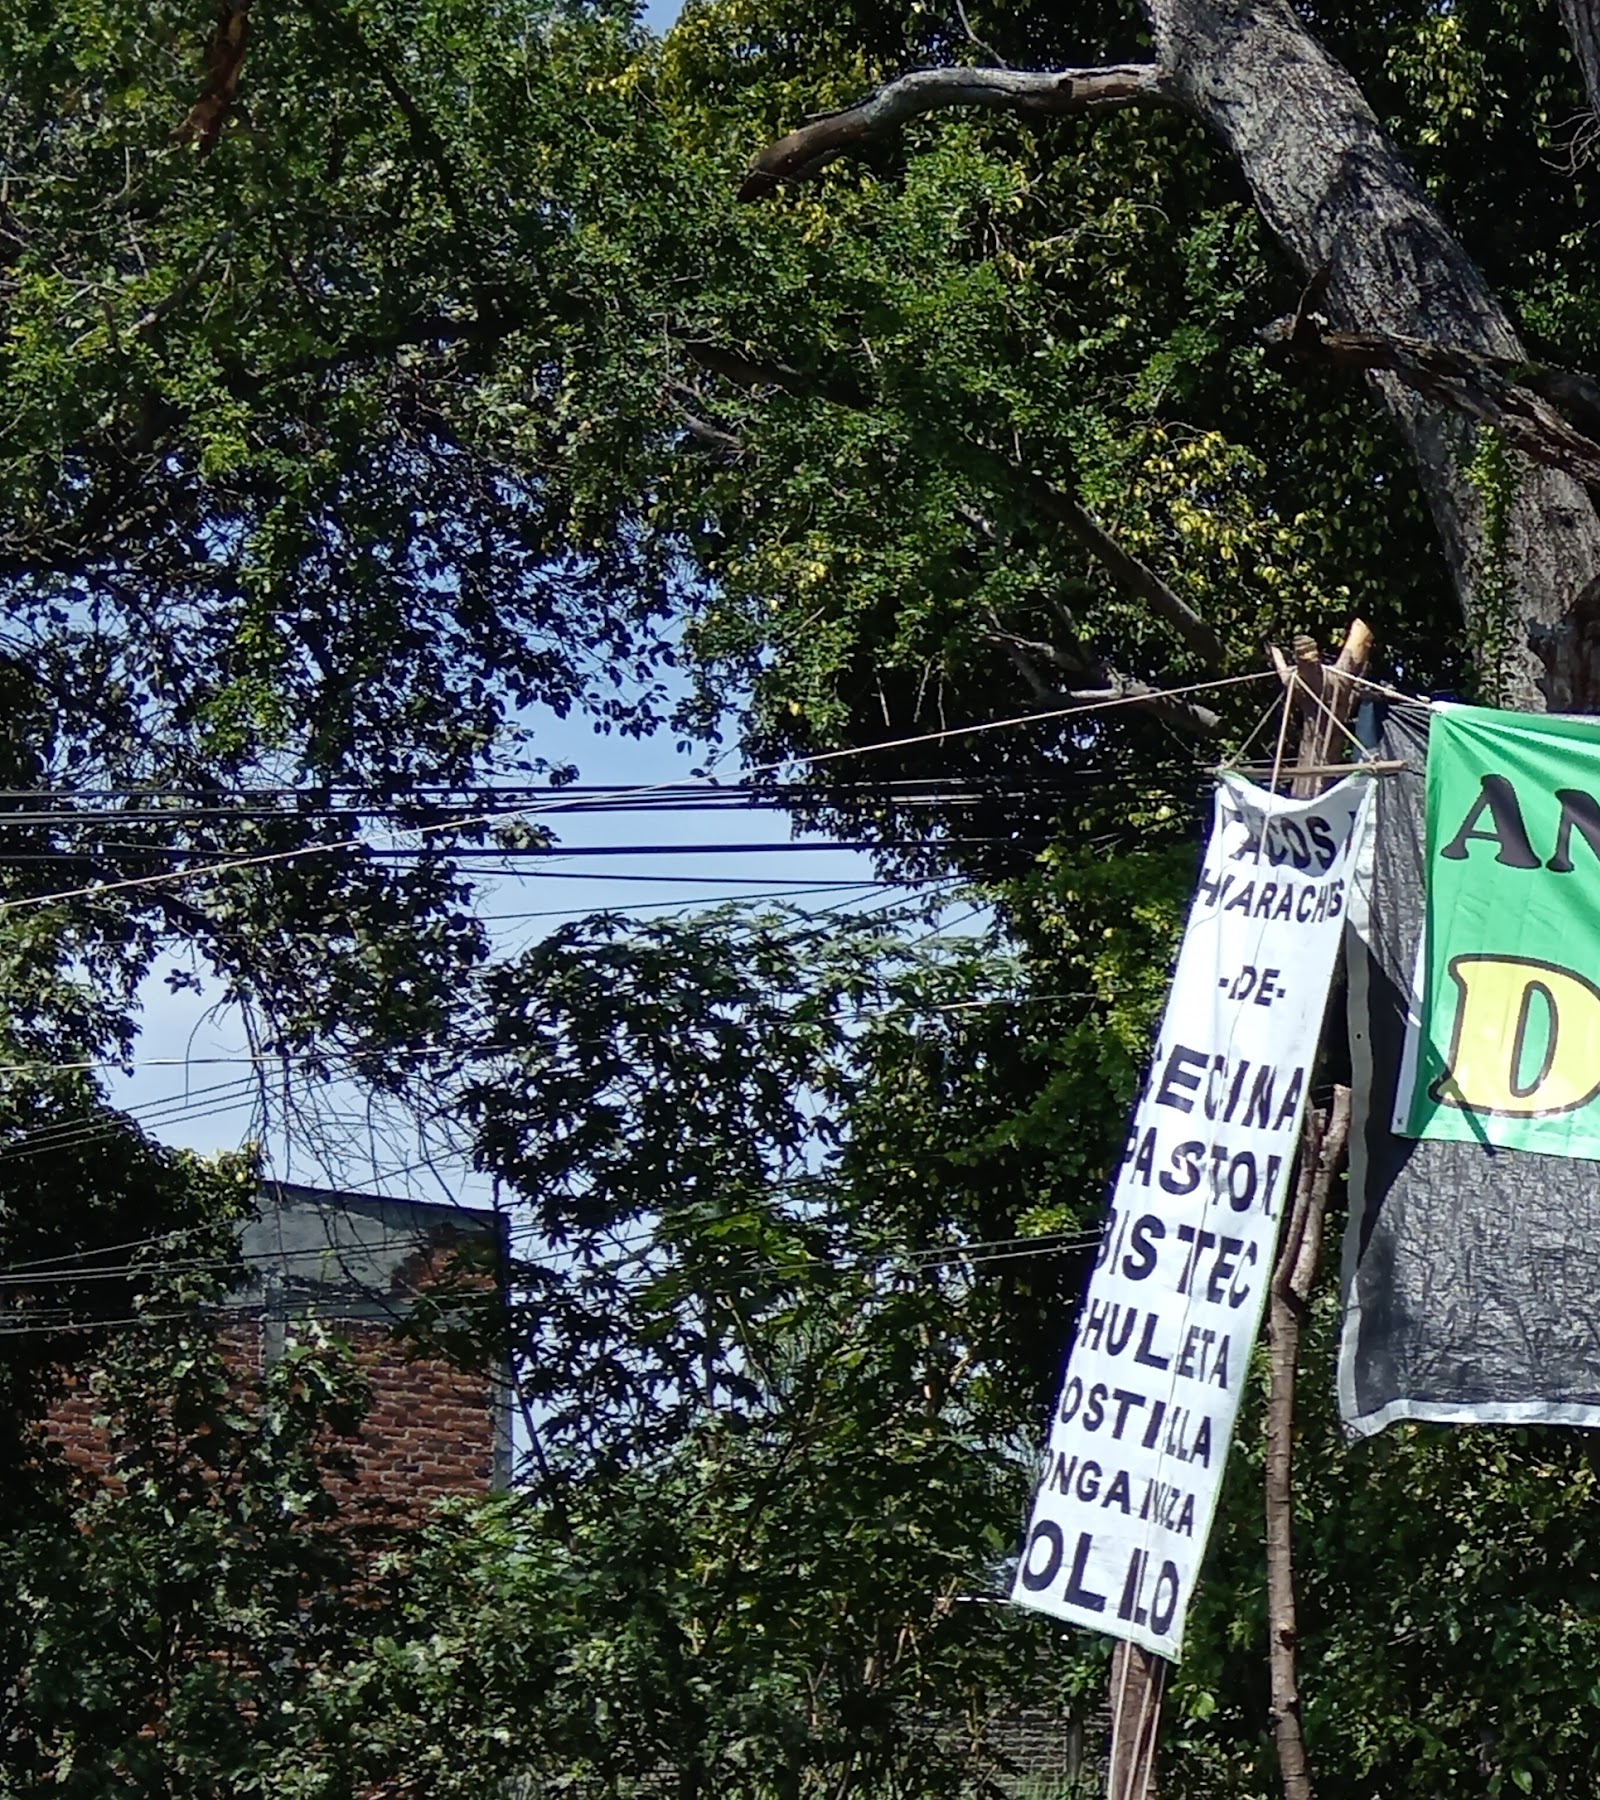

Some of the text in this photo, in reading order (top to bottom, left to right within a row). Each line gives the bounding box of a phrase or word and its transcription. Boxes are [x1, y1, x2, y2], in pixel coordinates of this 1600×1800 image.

[1218, 965, 1287, 1006] -DE-
[1143, 1042, 1305, 1132] ECINA
[1079, 1297, 1231, 1389] HULETA
[1061, 1376, 1212, 1469] OSTILLA
[1022, 1520, 1180, 1635] OLLO
